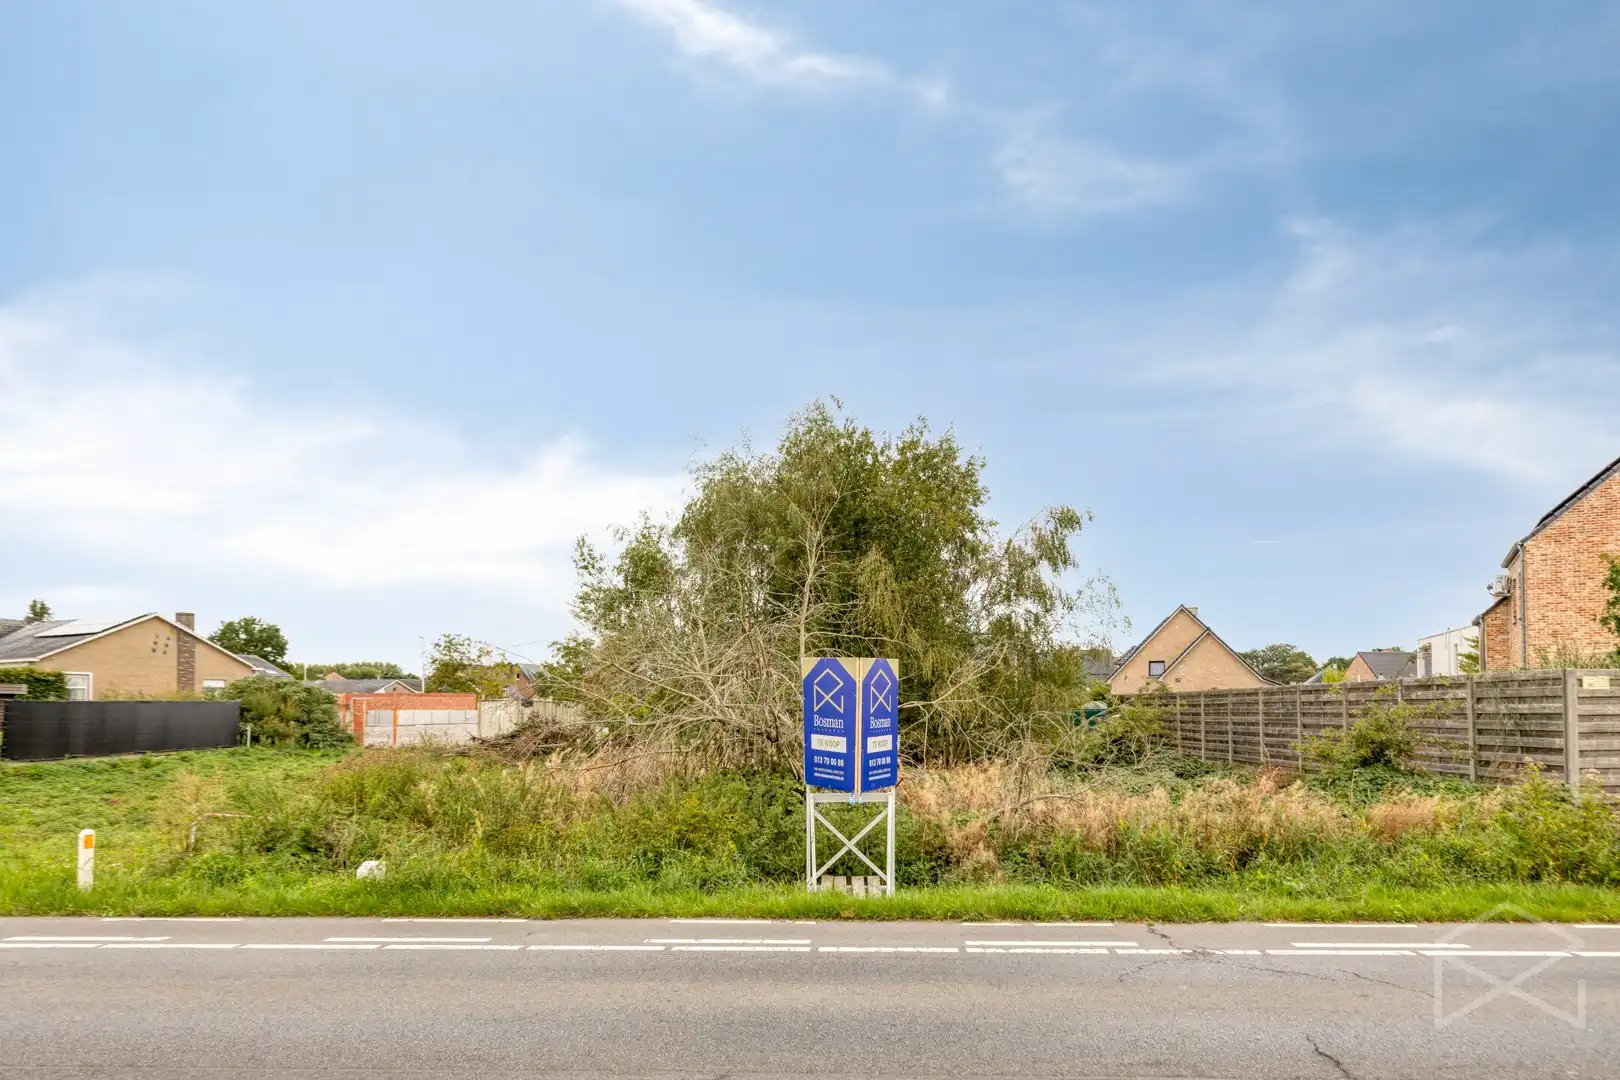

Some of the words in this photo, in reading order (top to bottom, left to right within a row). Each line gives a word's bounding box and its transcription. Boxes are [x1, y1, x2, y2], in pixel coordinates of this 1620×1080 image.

[814, 715, 844, 728] Bosman
[870, 717, 891, 728] Bosman
[817, 738, 823, 746] TE
[824, 739, 840, 747] KOOP
